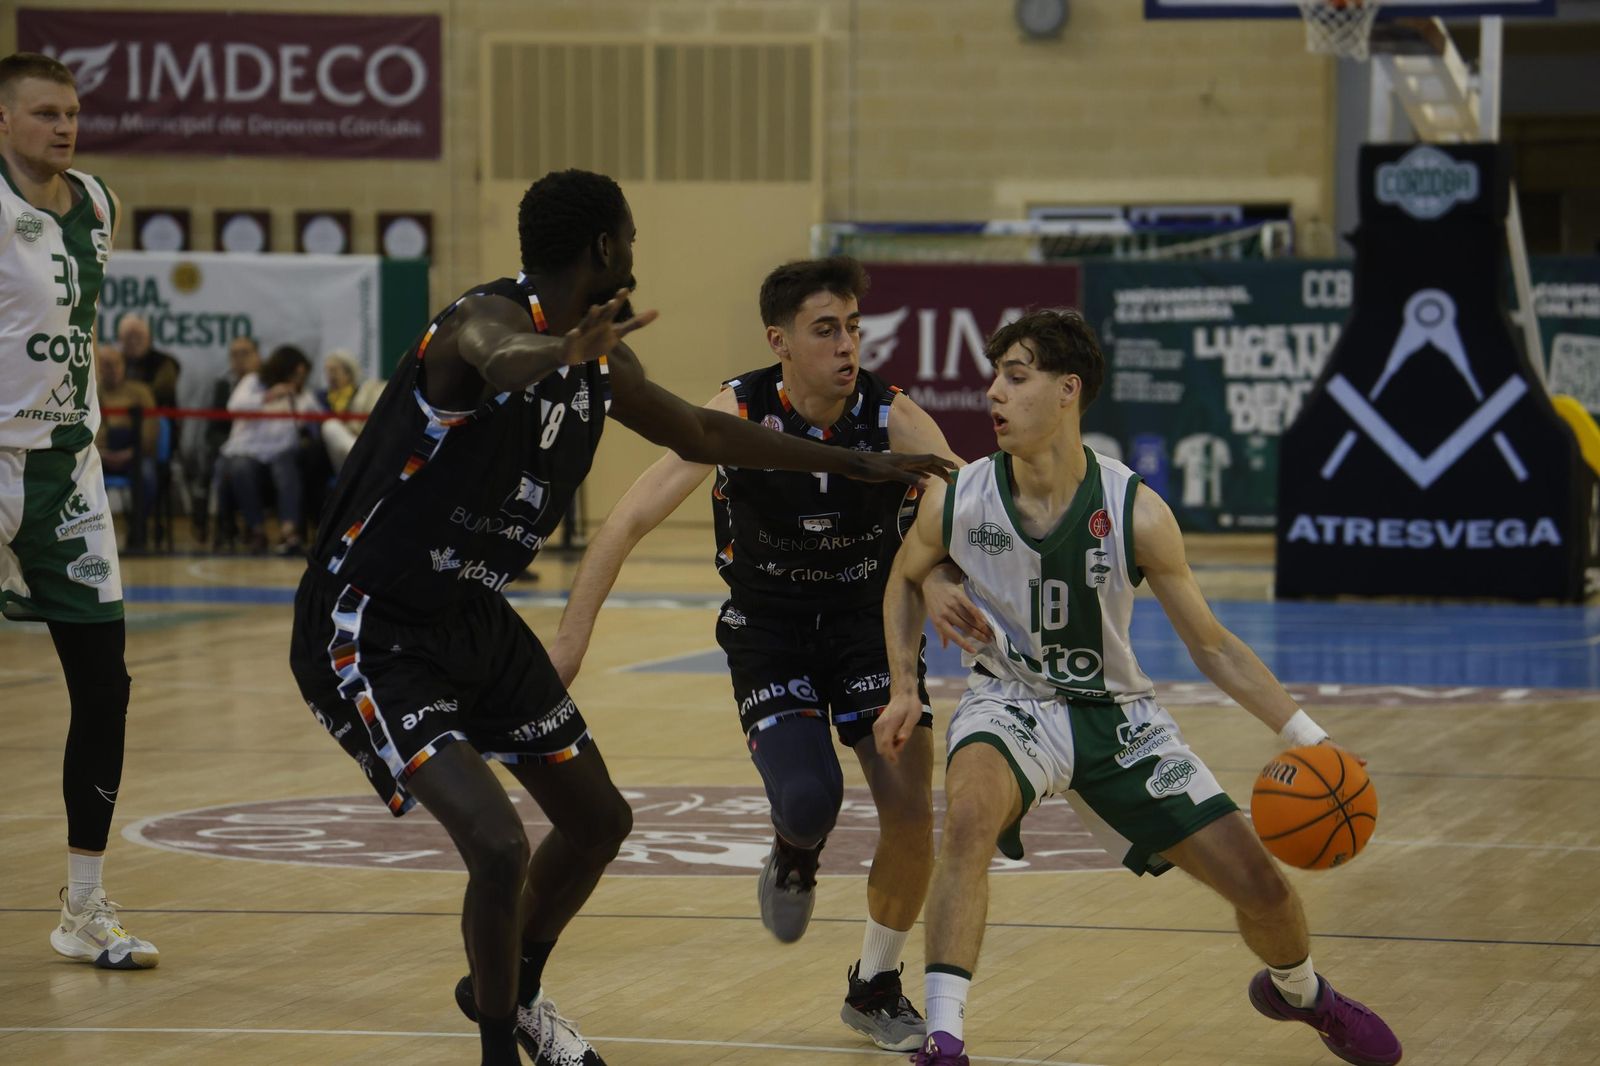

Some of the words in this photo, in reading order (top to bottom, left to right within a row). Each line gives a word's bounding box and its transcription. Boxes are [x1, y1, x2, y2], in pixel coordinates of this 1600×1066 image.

[126, 42, 427, 107] IMDECO
[51, 253, 82, 308] 31
[1286, 513, 1562, 549] ATRESVEGA
[1029, 578, 1069, 631] 18
[1118, 726, 1167, 760] Diputación
[1153, 761, 1195, 794] CORDOBA
